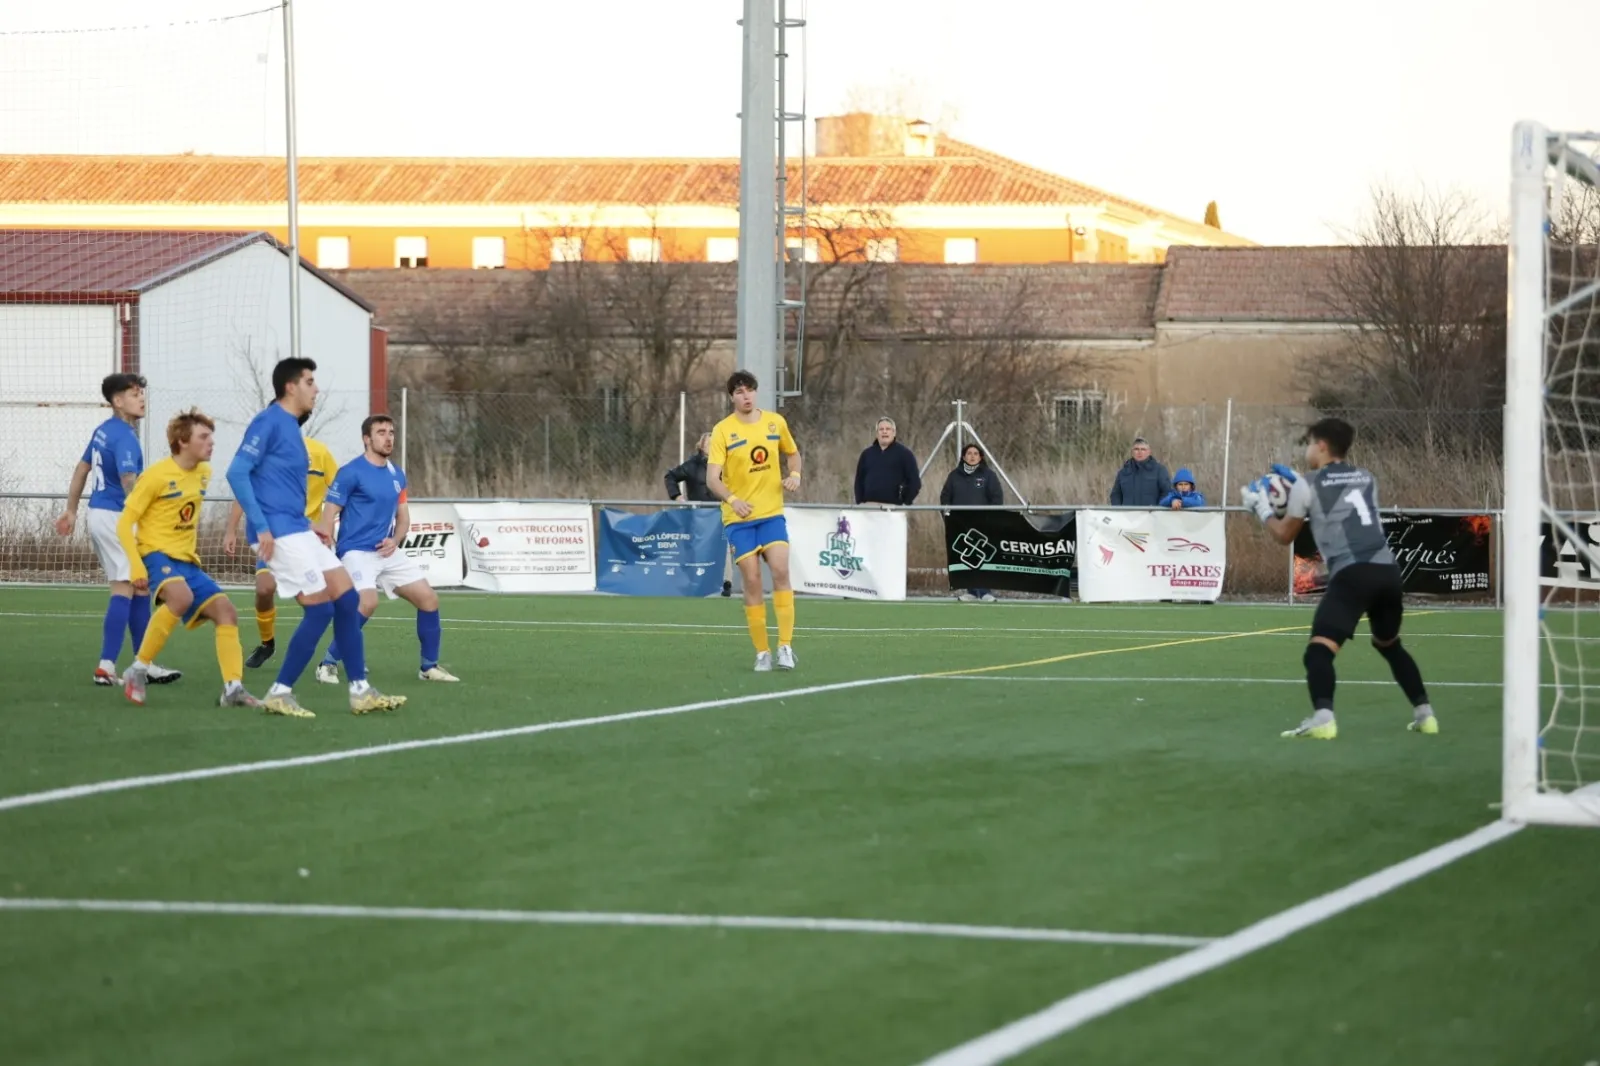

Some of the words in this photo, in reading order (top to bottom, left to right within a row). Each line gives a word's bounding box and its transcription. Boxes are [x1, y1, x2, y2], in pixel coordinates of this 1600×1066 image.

[1344, 489, 1373, 525] 1
[411, 522, 454, 532] ERES
[497, 525, 583, 534] CONSTRUCCIONES
[534, 537, 584, 545] REFORMAS
[632, 535, 656, 543] DIEGO
[656, 532, 679, 540] LÓPEZ
[1000, 539, 1076, 556] CERVISÁN
[405, 549, 446, 559] cing
[819, 551, 863, 571] SPORT
